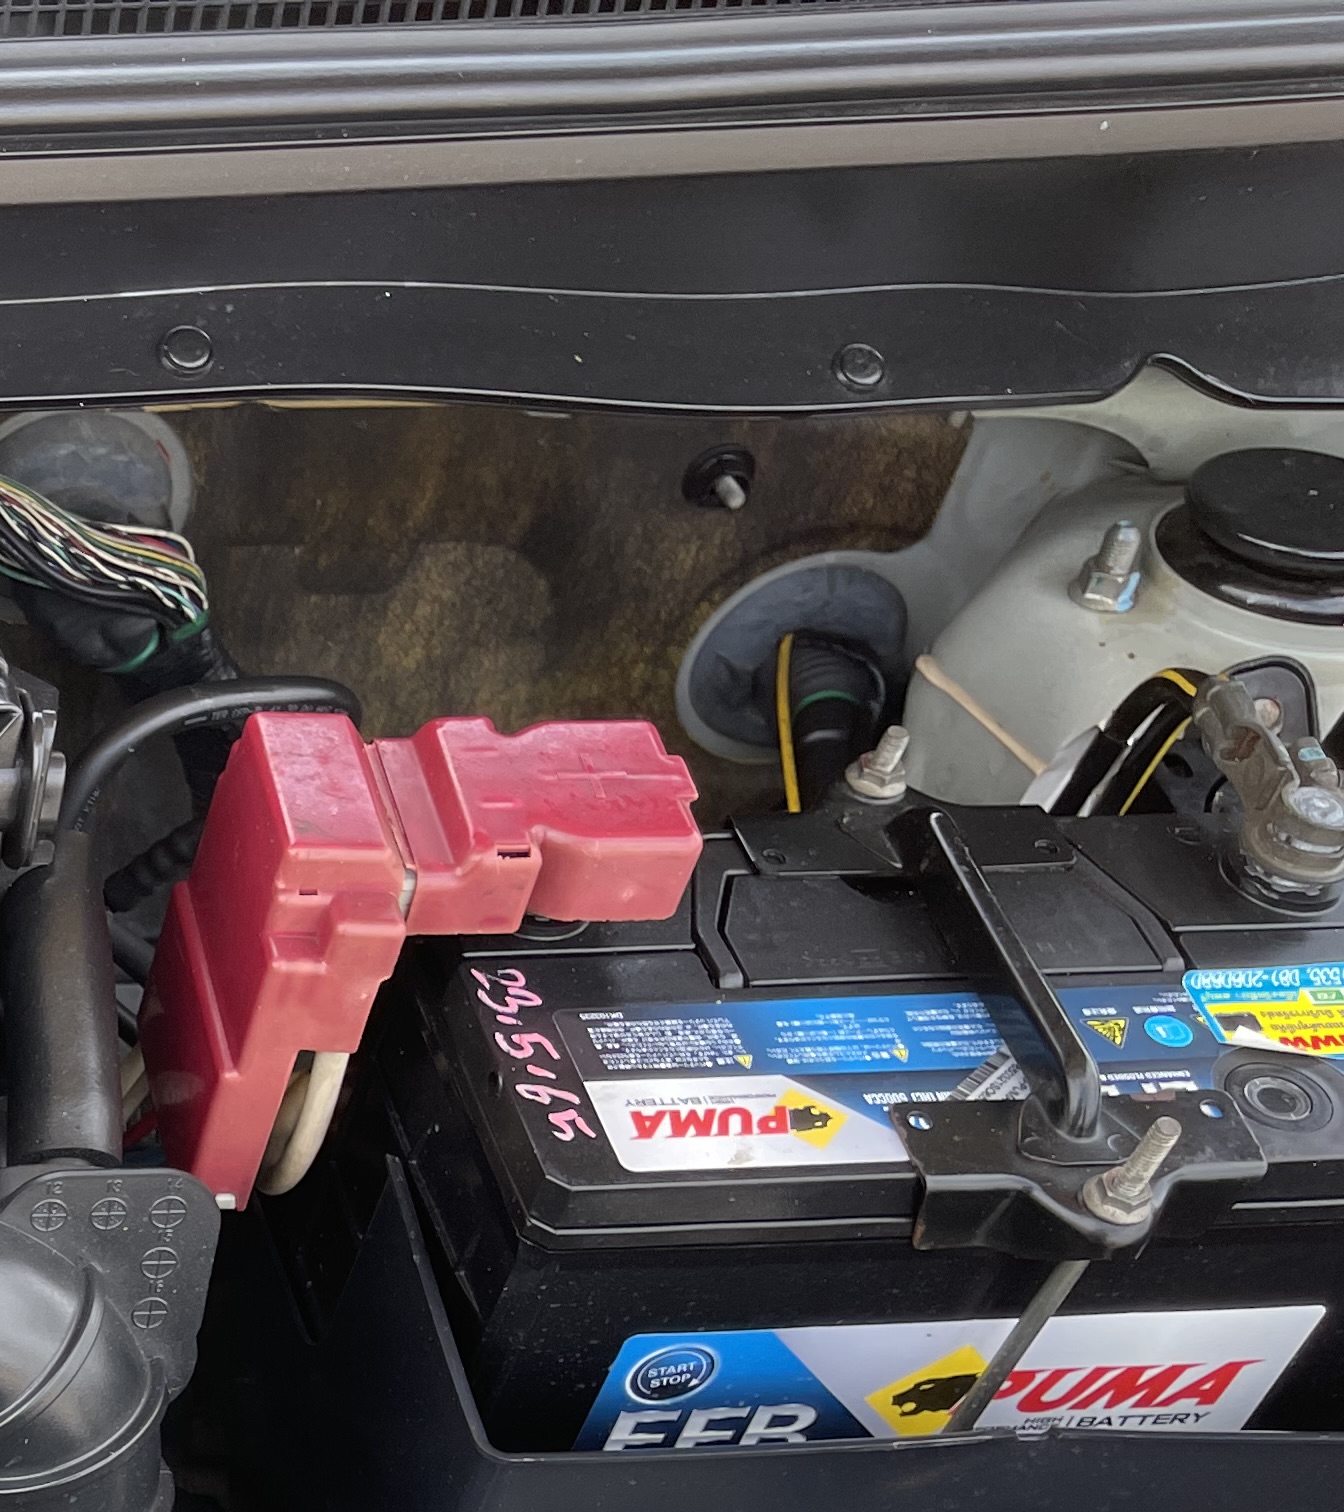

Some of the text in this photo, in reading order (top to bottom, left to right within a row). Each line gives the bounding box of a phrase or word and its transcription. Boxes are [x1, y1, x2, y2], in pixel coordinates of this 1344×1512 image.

[625, 1098, 701, 1108] BATTERY
[629, 1105, 790, 1141] PUMA
[647, 1360, 697, 1378] START
[649, 1373, 691, 1389] STOP
[1076, 1411, 1212, 1428] BATTERY
